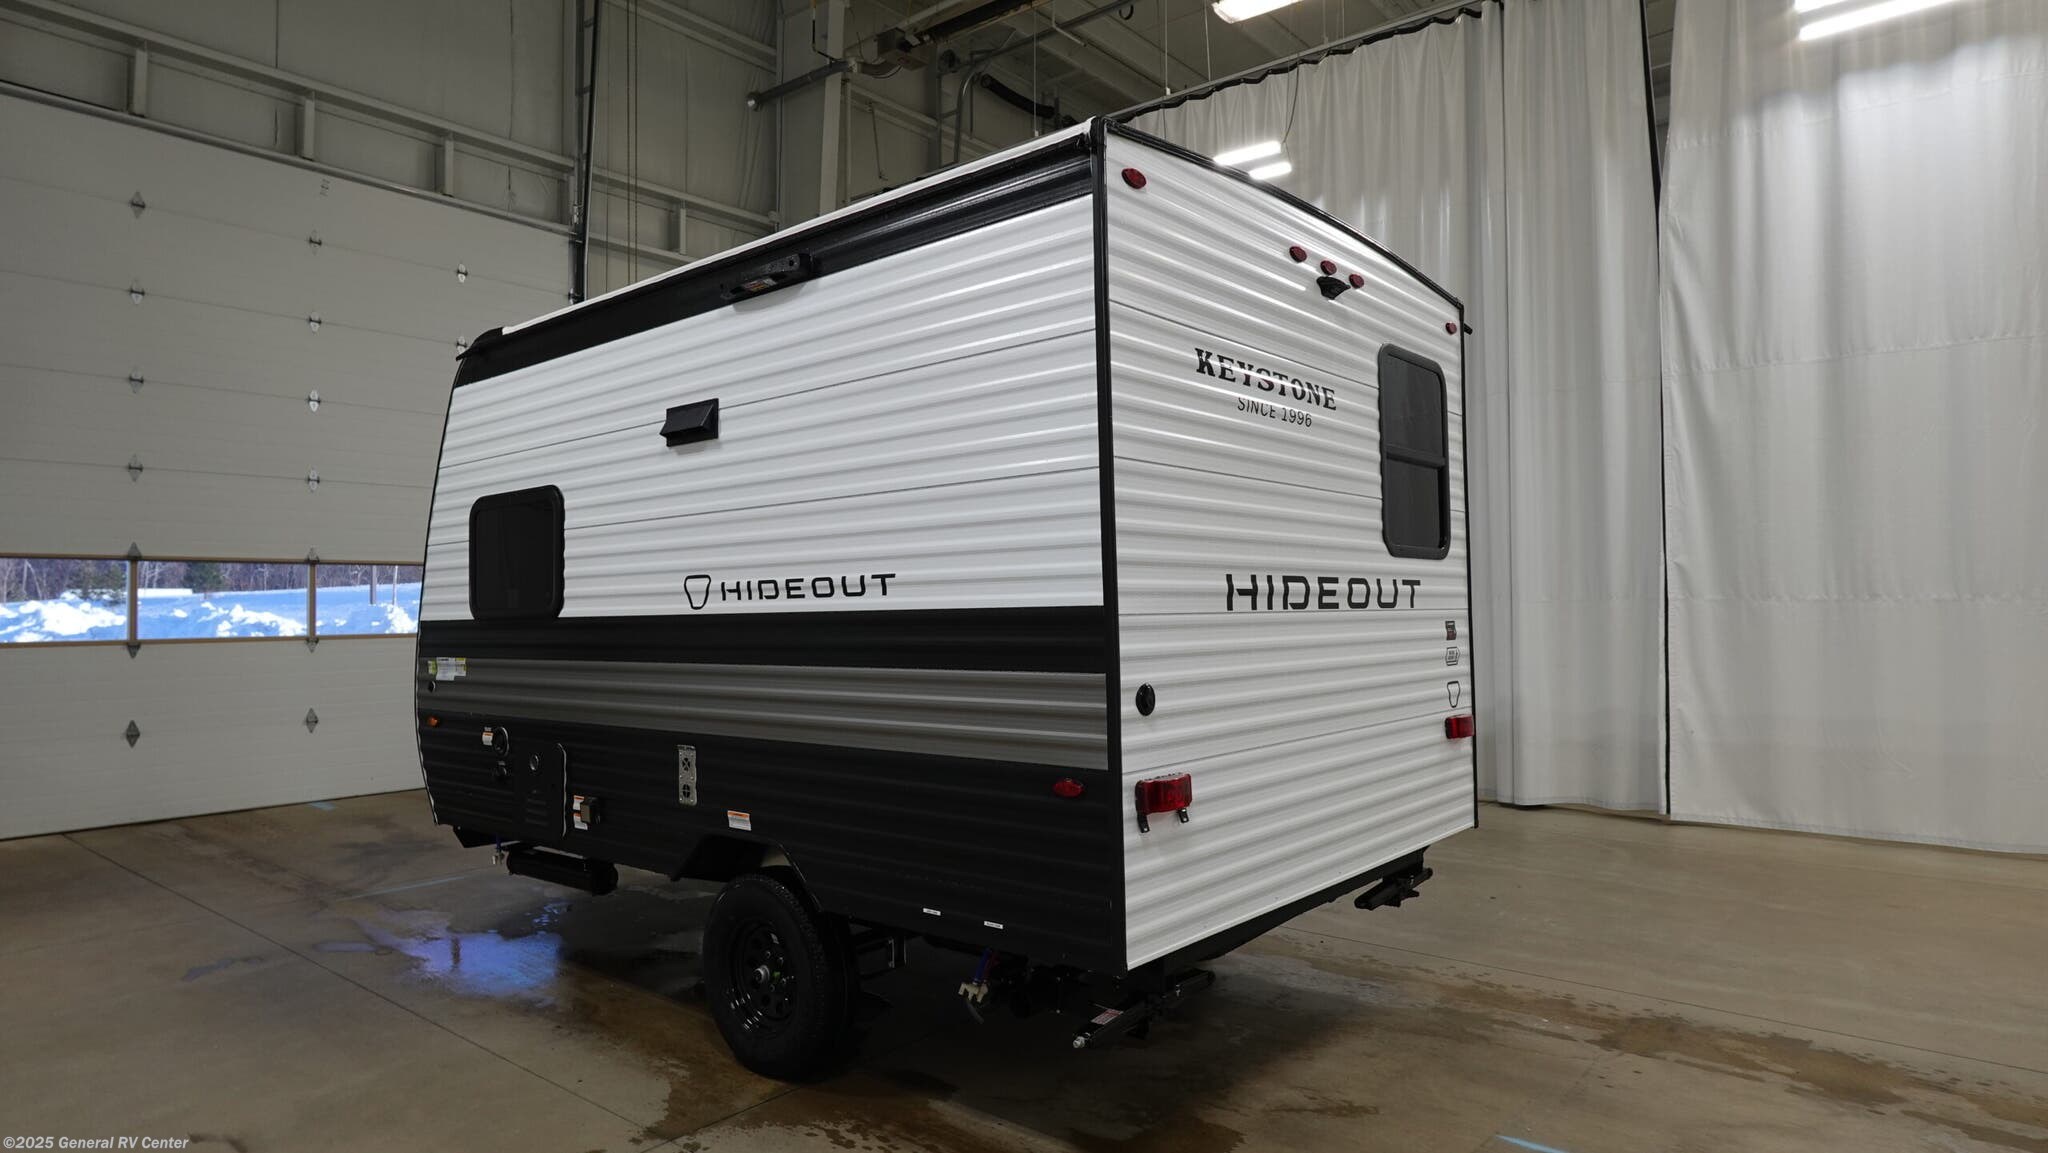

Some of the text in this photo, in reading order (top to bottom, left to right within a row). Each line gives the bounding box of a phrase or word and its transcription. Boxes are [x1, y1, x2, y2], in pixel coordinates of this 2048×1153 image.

[1194, 347, 1337, 411] KEYSTONE
[1237, 396, 1313, 428] SINCE 1996
[720, 573, 896, 601] HIDEOUT
[1225, 573, 1421, 611] HIDEOUT
